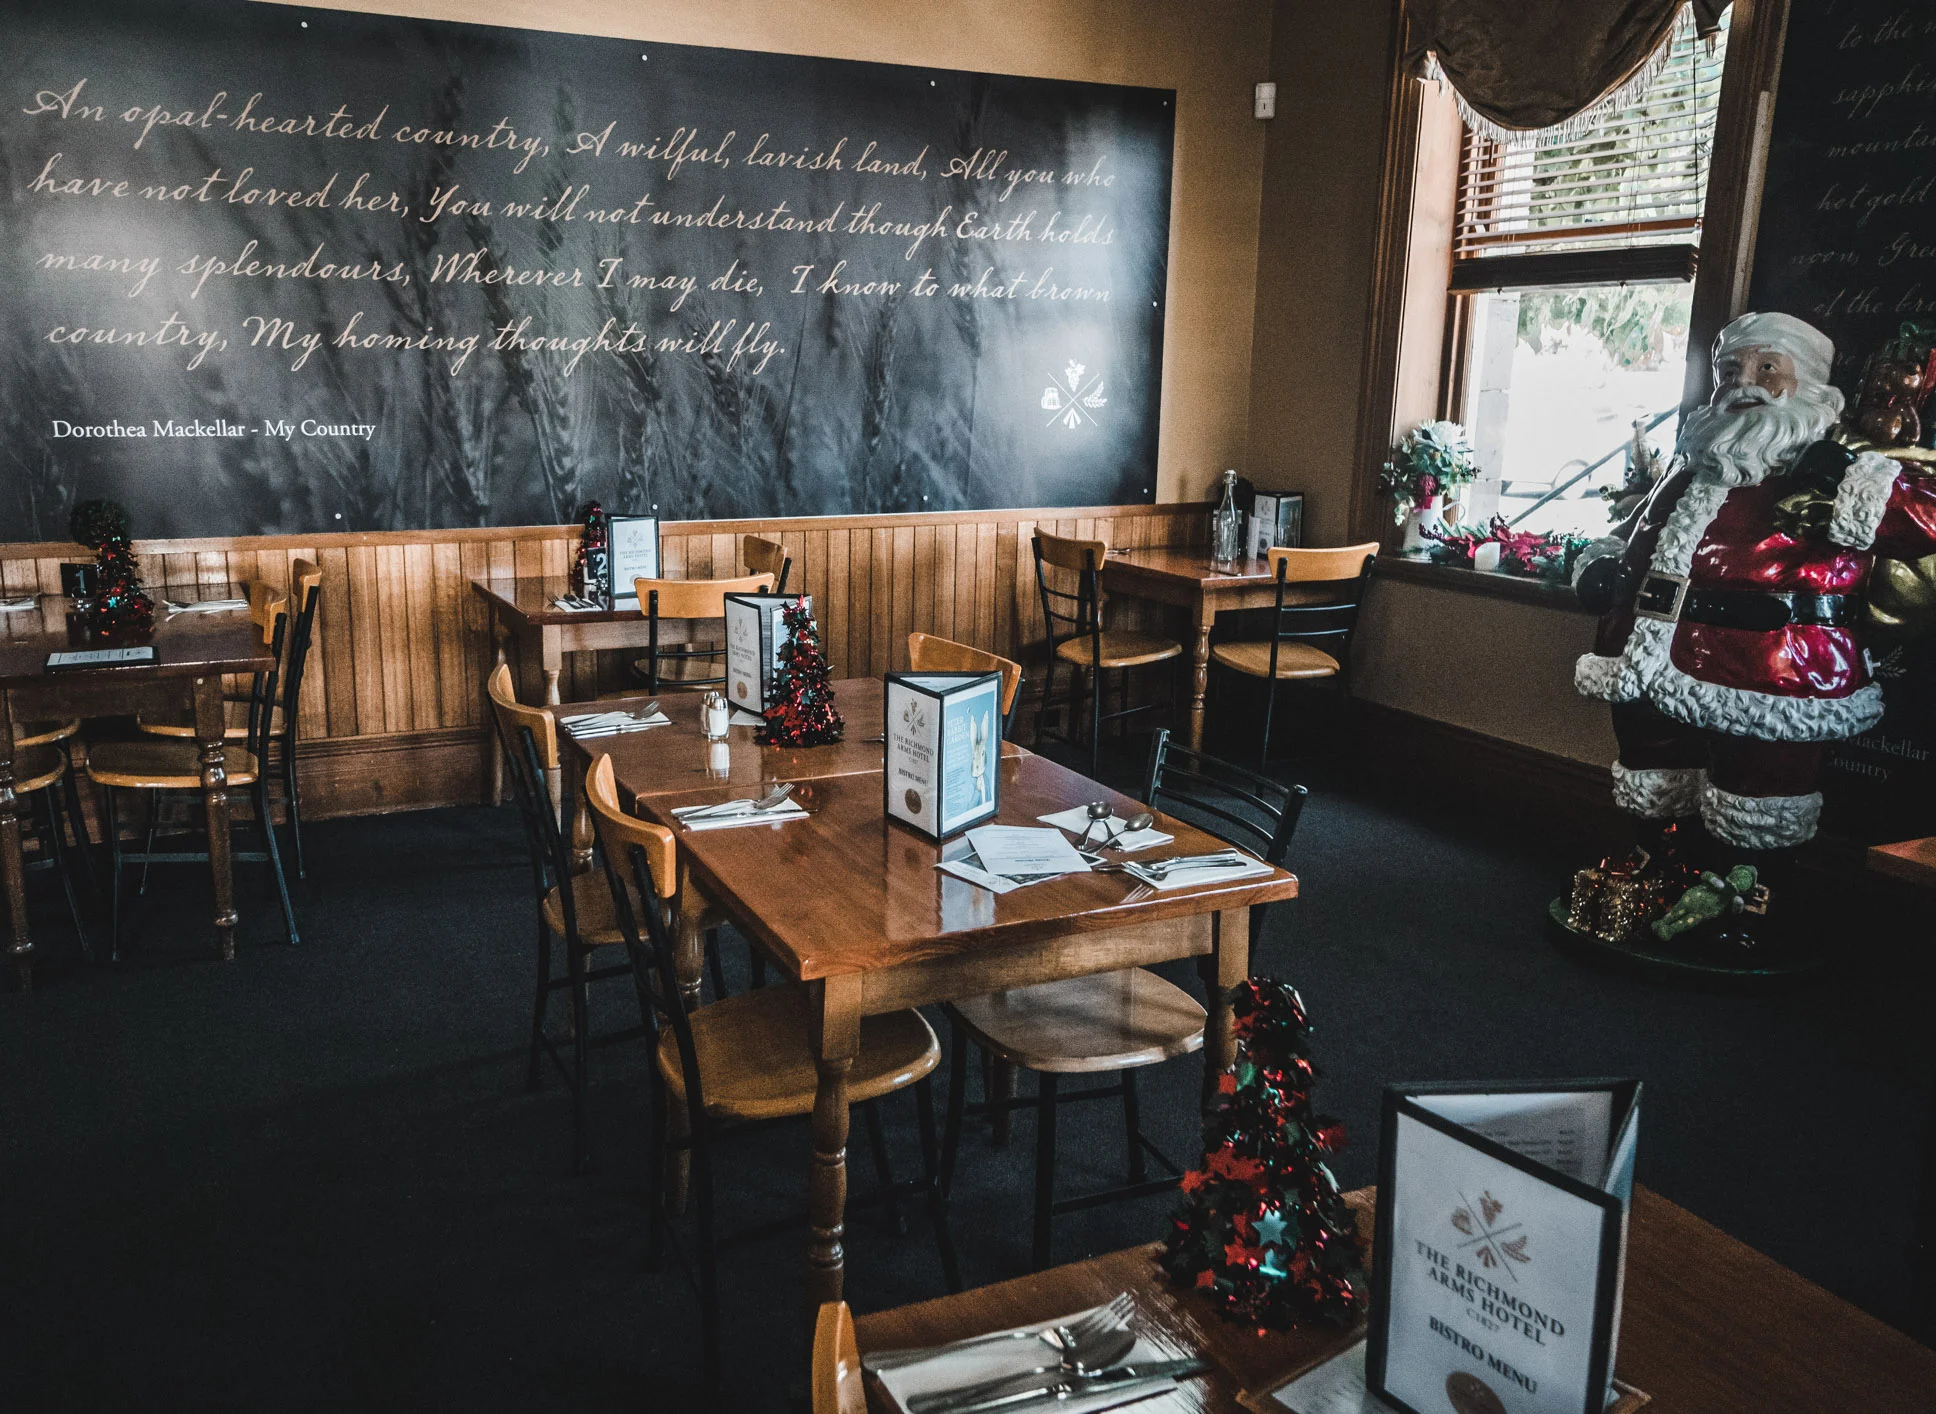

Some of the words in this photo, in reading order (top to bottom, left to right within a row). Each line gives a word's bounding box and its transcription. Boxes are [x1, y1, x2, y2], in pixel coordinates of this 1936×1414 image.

[1836, 24, 1863, 50] to
[1873, 8, 1913, 44] the
[23, 78, 106, 122] An
[119, 91, 389, 149] opal-hearted
[391, 116, 549, 174] country,
[566, 121, 617, 157] A
[615, 127, 730, 180] wilful,
[742, 133, 848, 171] lavish
[851, 141, 930, 181] land,
[941, 147, 1008, 181] All
[998, 168, 1055, 202] you
[1061, 155, 1115, 188] who
[27, 152, 129, 194] have
[138, 168, 228, 202] not
[221, 167, 339, 209] loved
[339, 173, 409, 218] her,
[419, 185, 493, 223] You
[500, 184, 590, 222] will
[582, 193, 655, 224] not
[649, 195, 845, 232] understand
[842, 202, 952, 260] though
[956, 211, 1037, 242] Earth
[1037, 212, 1116, 245] holds
[1817, 182, 1871, 210] hot
[1856, 176, 1936, 228] gold
[35, 253, 162, 298] many
[176, 239, 411, 299] splendours,
[430, 248, 583, 287] Wherever
[597, 257, 623, 288] I
[626, 274, 698, 312] may
[707, 258, 764, 297] die,
[790, 264, 815, 294] I
[818, 260, 901, 298] know
[908, 268, 940, 298] to
[947, 267, 1028, 300] what
[1027, 267, 1112, 302] brown
[1846, 286, 1883, 313] the
[44, 311, 227, 371] country,
[242, 315, 323, 372] My
[331, 311, 480, 376] homing
[486, 315, 647, 377] thoughts
[654, 319, 726, 354] will
[730, 319, 785, 375] fly.
[51, 419, 147, 438] Dorothea
[152, 419, 245, 438] Mackellar
[264, 419, 295, 441] My
[300, 419, 376, 441] Country
[893, 732, 904, 743] THE
[904, 737, 934, 756] RICHMOND
[897, 743, 911, 755] ARMS
[912, 749, 930, 763] HOTEL
[1415, 1239, 1450, 1271] THE
[1456, 1263, 1565, 1336] RICHMOND
[1428, 1266, 1475, 1303] ARMS
[1482, 1296, 1546, 1346] HOTEL
[1429, 1315, 1485, 1360] BISTRO
[1487, 1353, 1538, 1394] MENU
